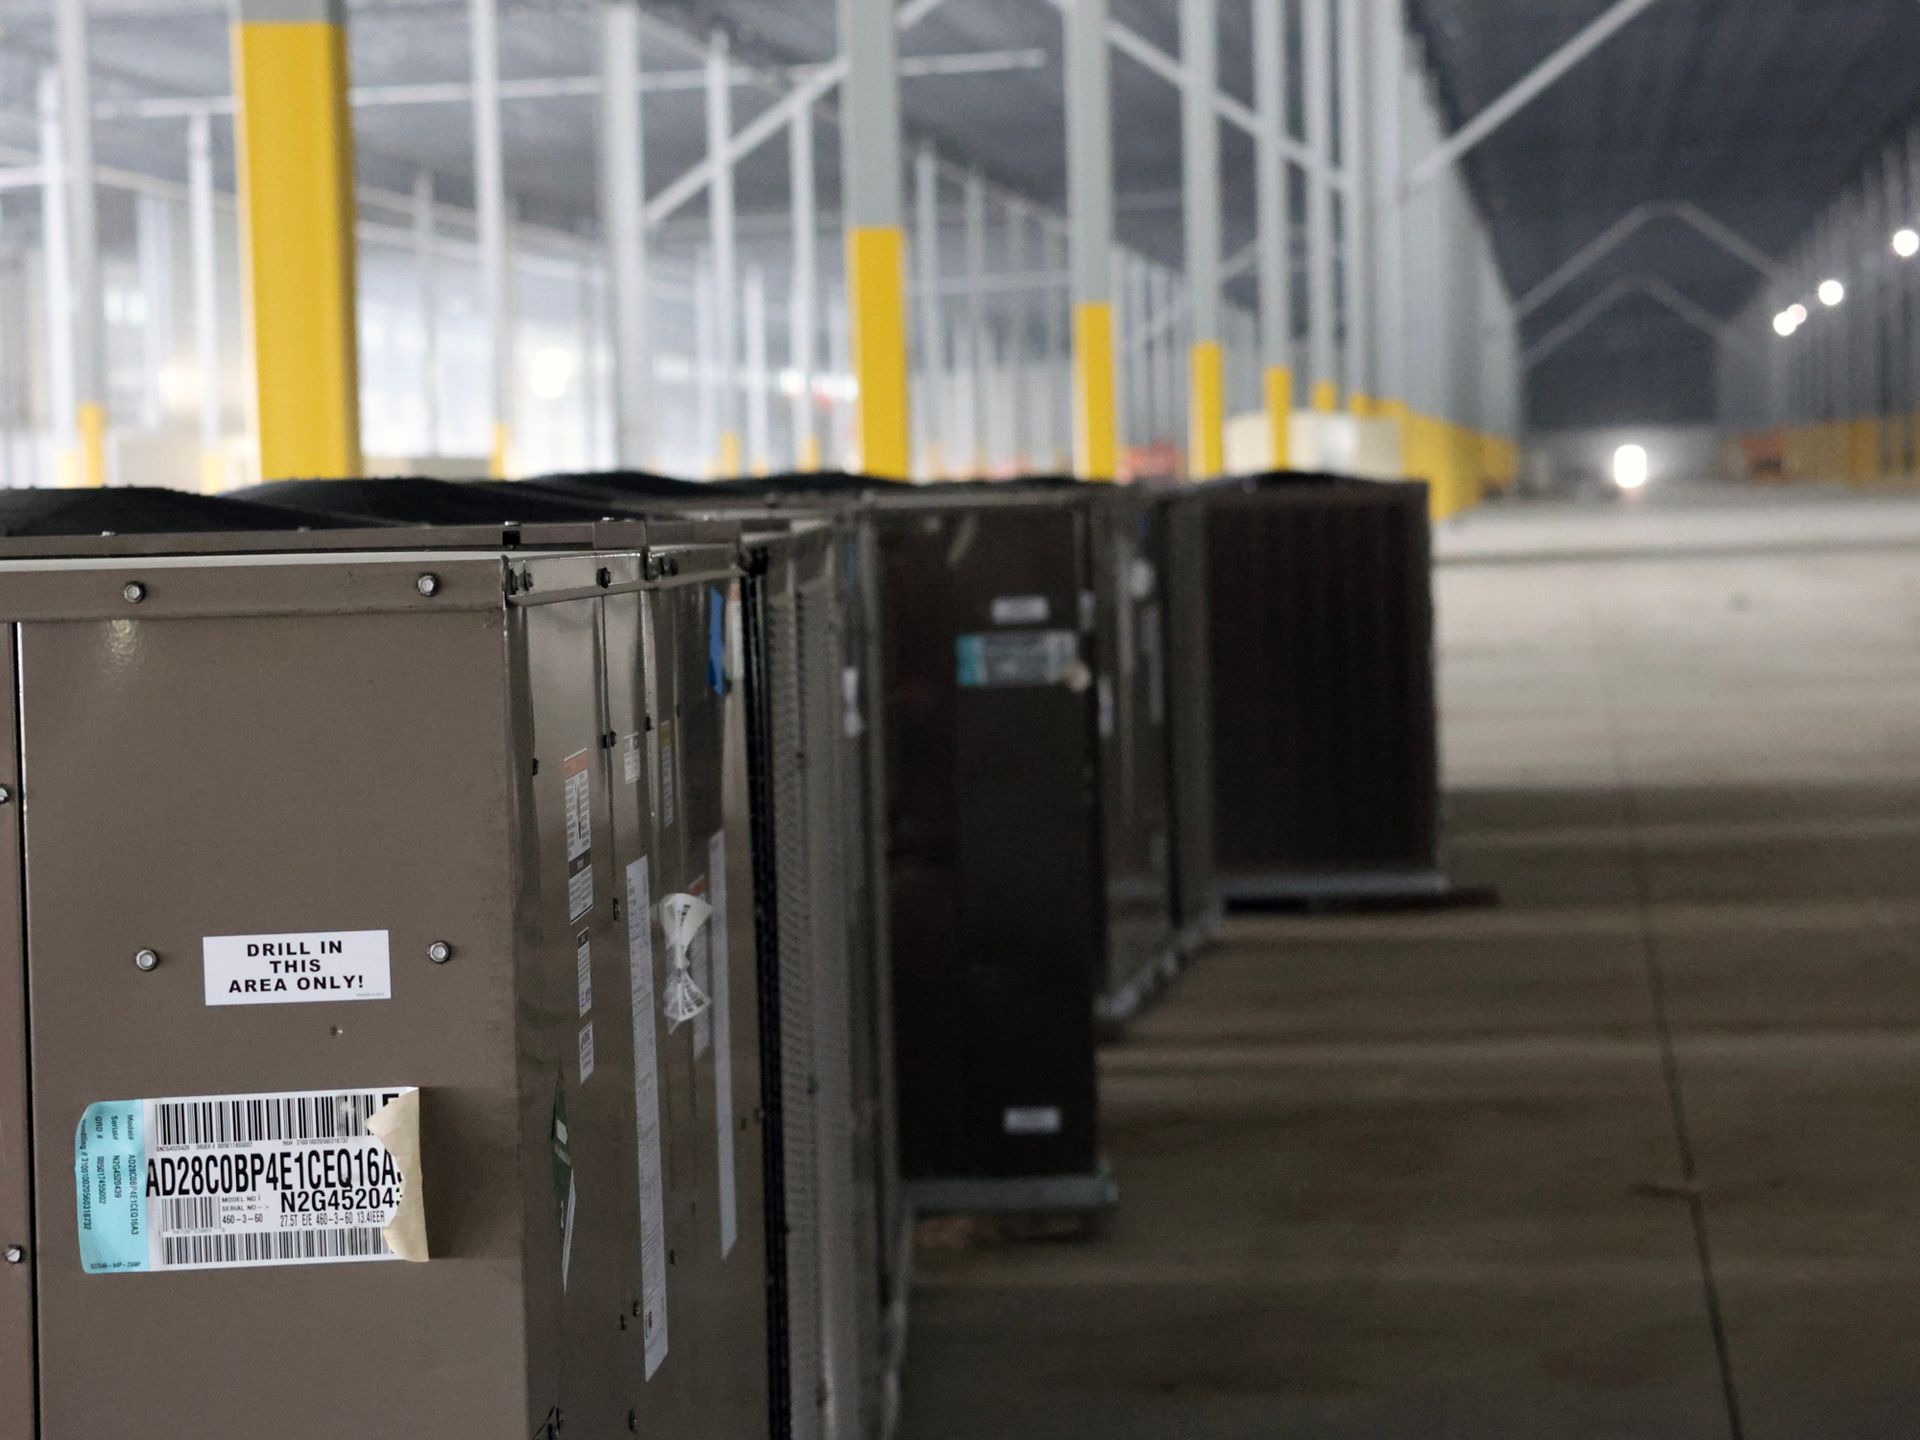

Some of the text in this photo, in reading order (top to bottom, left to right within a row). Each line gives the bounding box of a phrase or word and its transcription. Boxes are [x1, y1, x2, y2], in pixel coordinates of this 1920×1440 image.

[247, 940, 343, 957] DRILL IN
[269, 958, 322, 974] THIS
[228, 975, 364, 993] AREA ONLY!
[146, 1147, 403, 1198] AD28C0BP4E1CEQ16A
[280, 1187, 402, 1213] N2G45204
